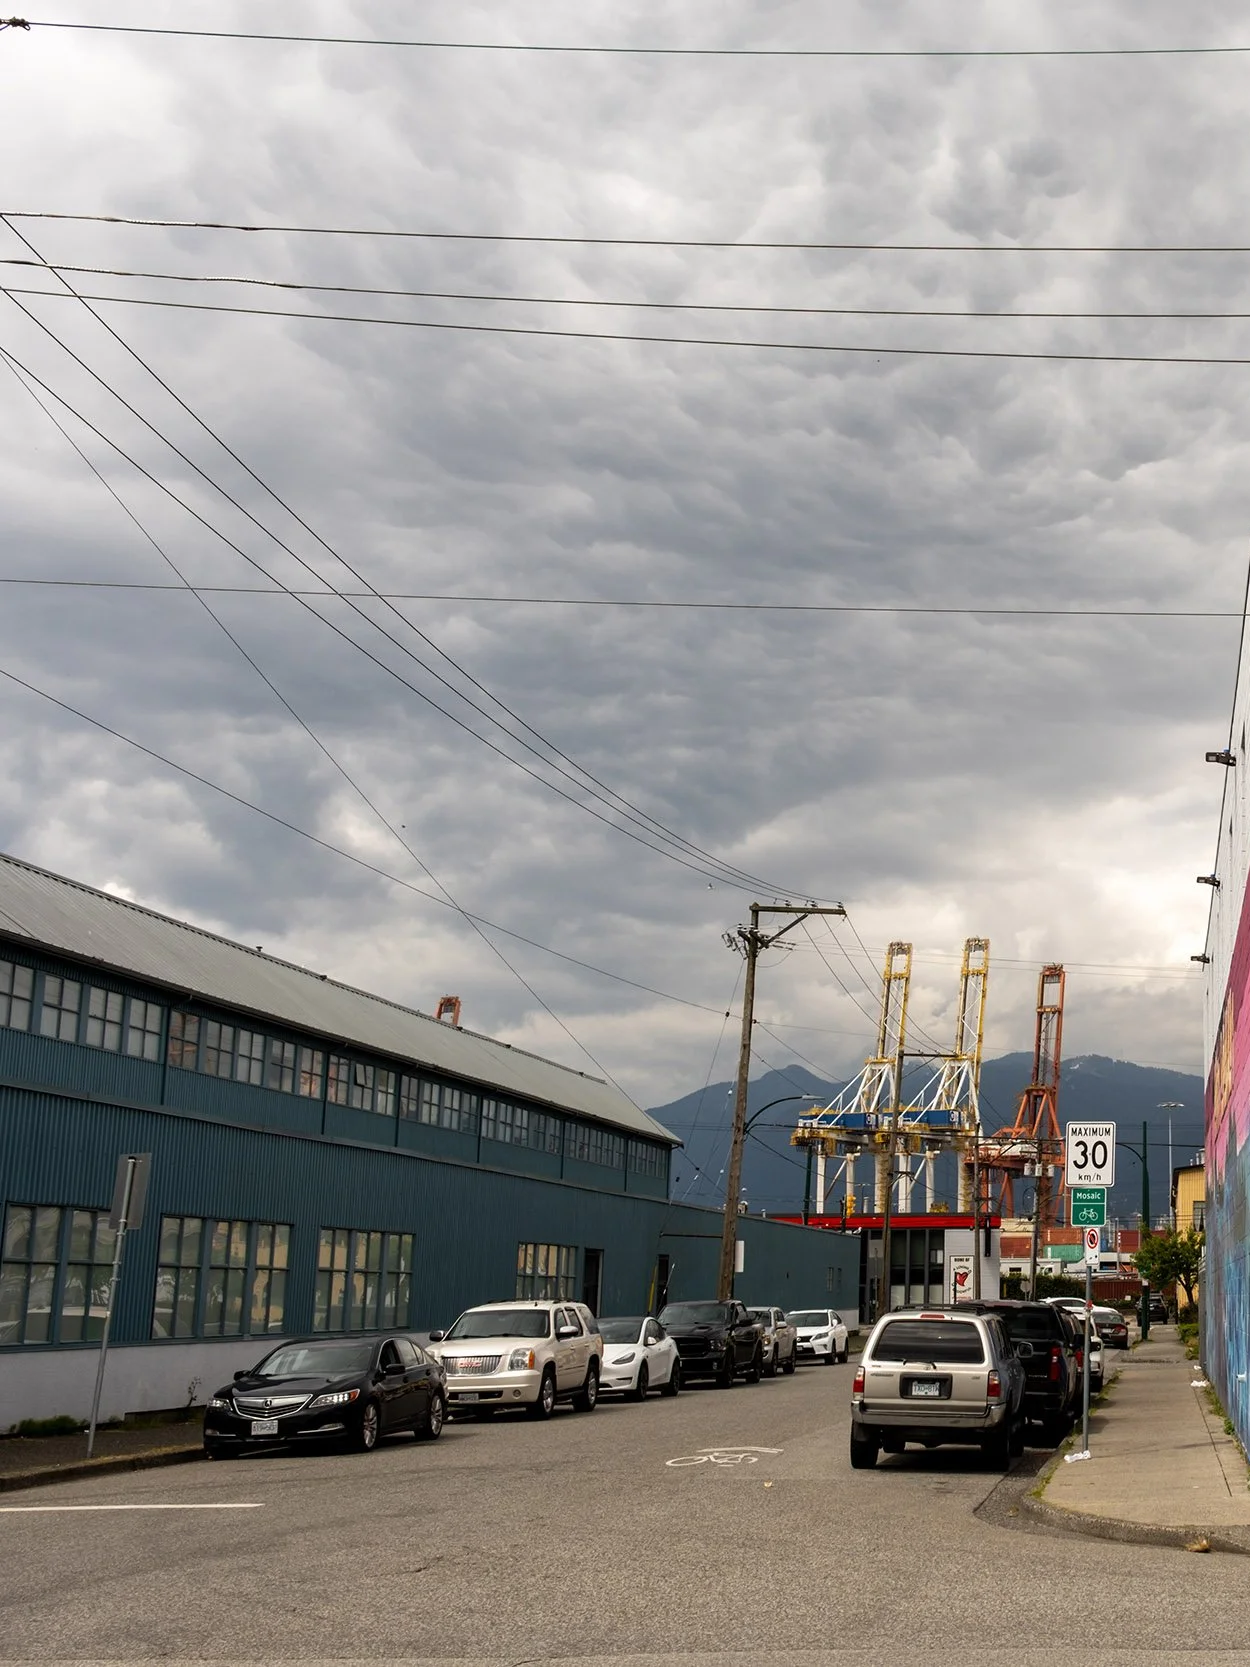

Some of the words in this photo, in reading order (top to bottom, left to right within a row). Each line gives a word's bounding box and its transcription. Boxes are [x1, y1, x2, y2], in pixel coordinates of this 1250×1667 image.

[1071, 1127, 1111, 1137] MAXIMUM
[1073, 1140, 1108, 1169] 30
[1078, 1172, 1102, 1181] km/h
[1076, 1191, 1101, 1200] Mosaic
